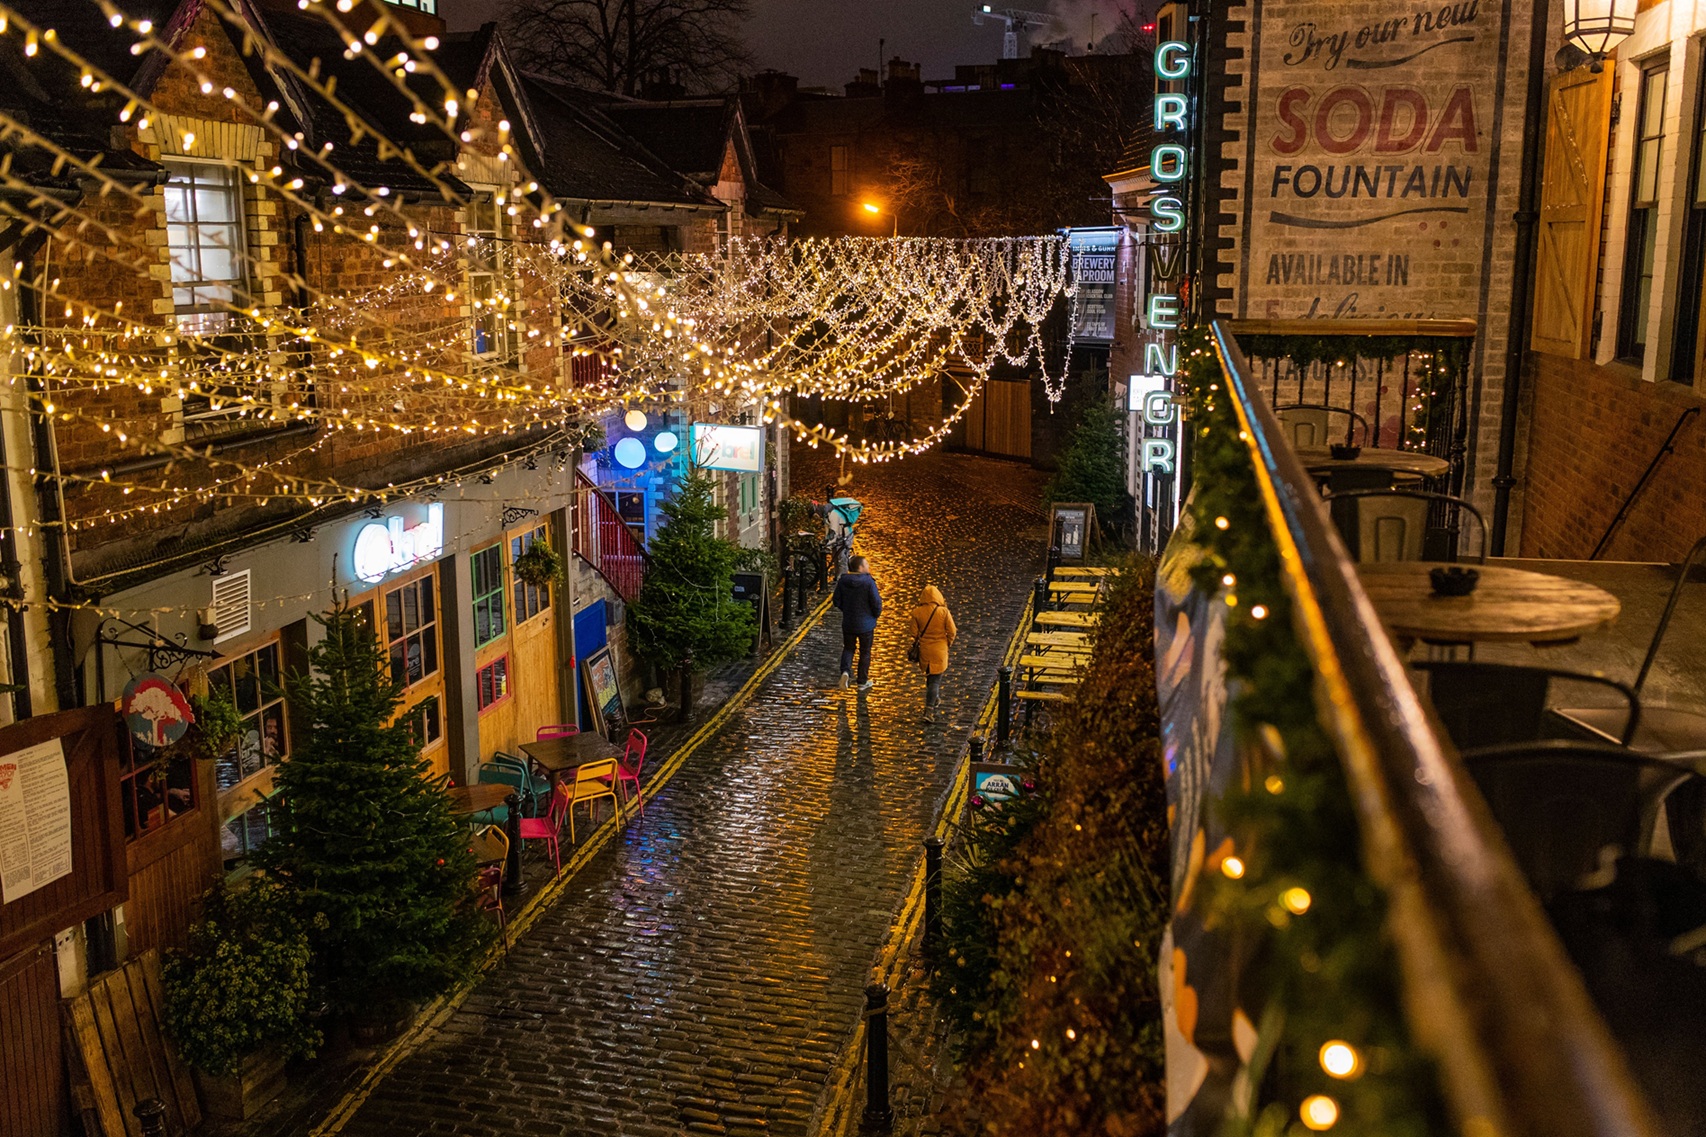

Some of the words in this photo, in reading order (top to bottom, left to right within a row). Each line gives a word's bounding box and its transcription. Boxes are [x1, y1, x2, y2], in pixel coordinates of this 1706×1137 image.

[1283, 22, 1350, 71] Try
[1355, 16, 1408, 50] our
[1413, 0, 1479, 36] new
[1270, 86, 1480, 155] SODA
[1270, 164, 1472, 199] FOUNTAIN
[1072, 258, 1115, 269] BREWERY
[1091, 244, 1098, 252] &
[1142, 40, 1191, 474] GROSVENOR
[1072, 270, 1115, 281] TAPROOM
[1266, 254, 1381, 286] AVAILABLE
[1386, 254, 1410, 286] IN
